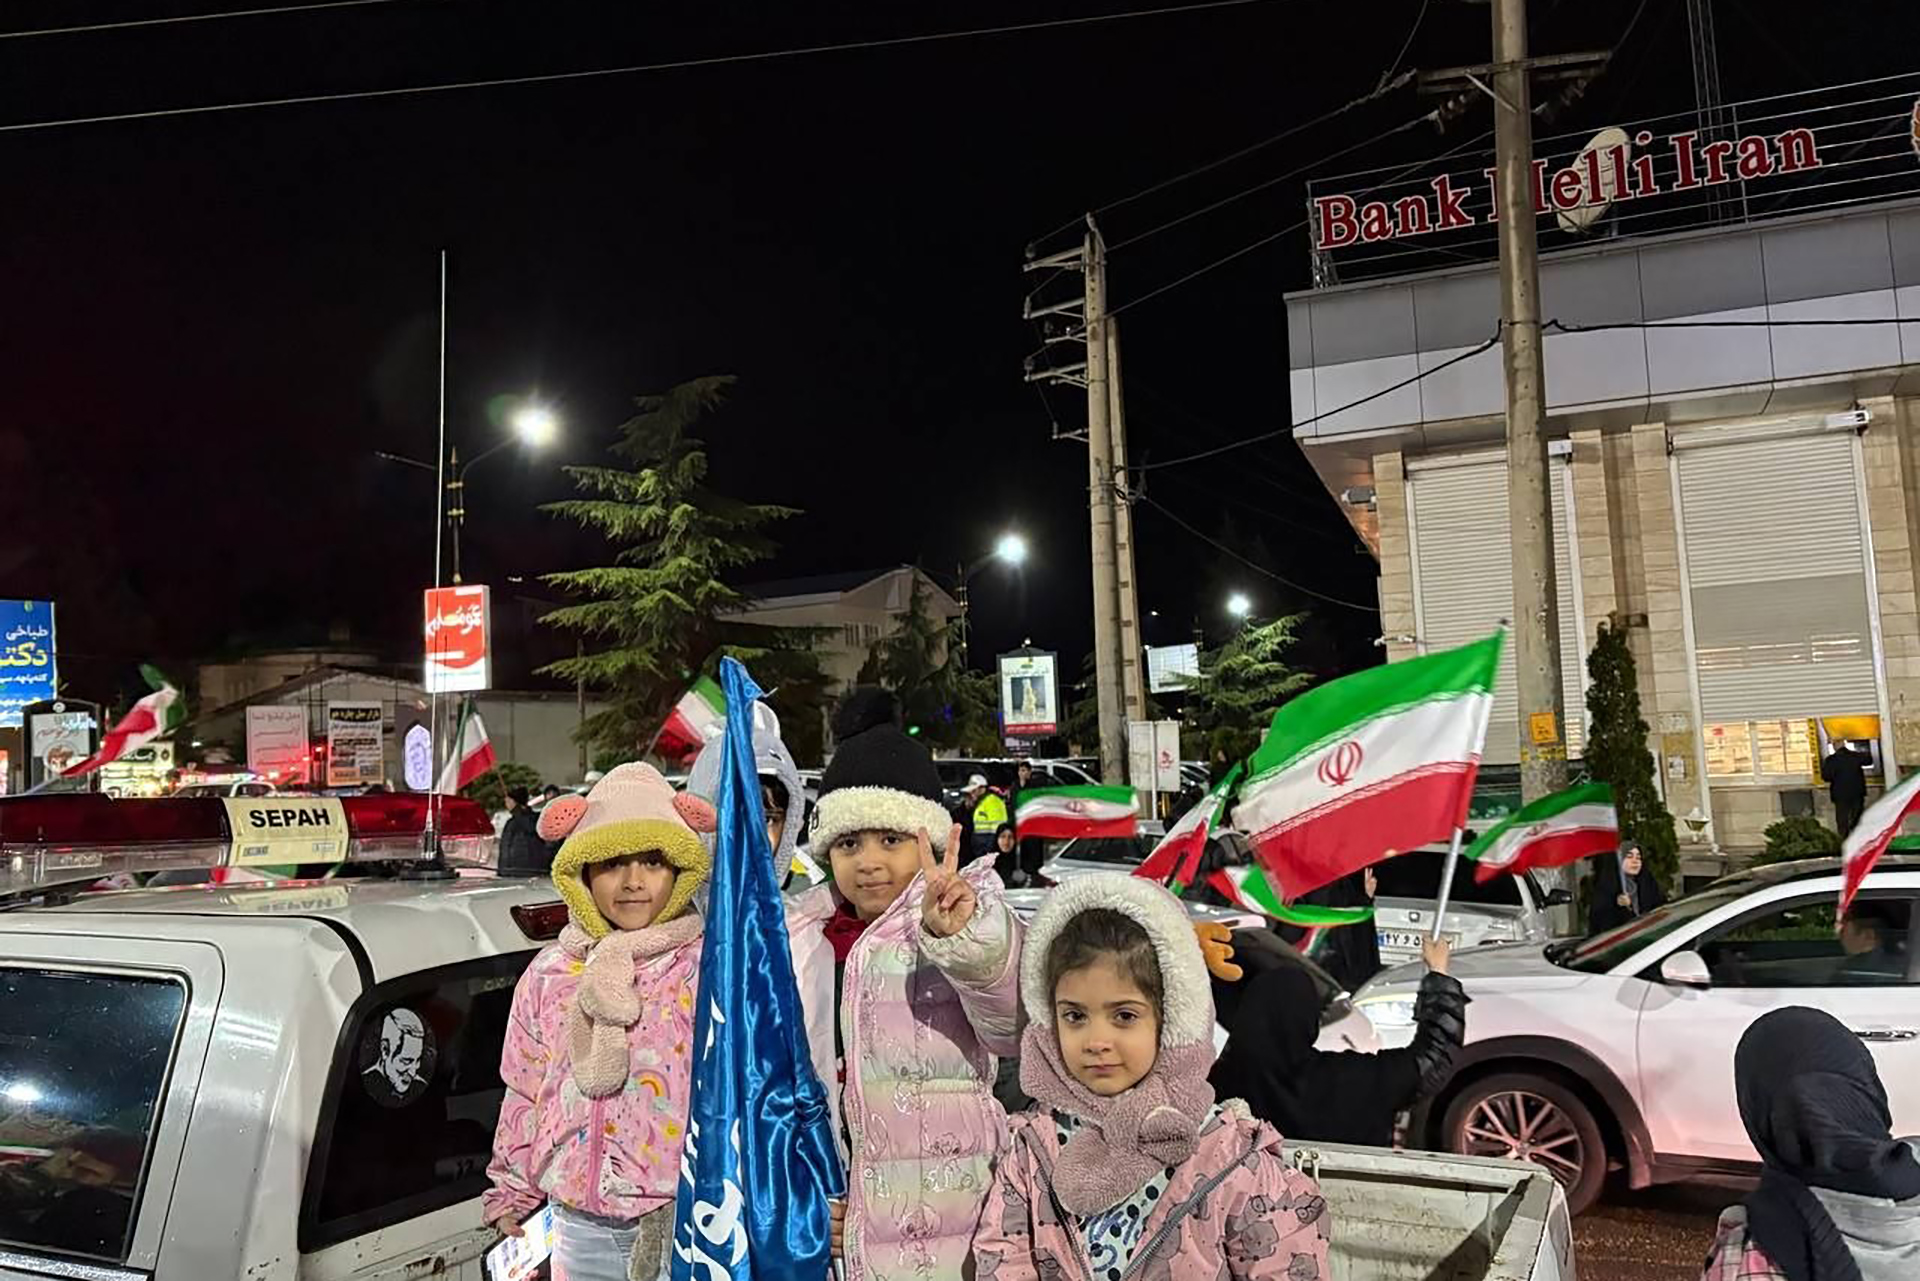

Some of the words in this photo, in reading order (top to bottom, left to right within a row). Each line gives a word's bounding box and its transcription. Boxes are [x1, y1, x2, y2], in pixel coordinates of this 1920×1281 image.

[1314, 173, 1475, 250] Bank
[1669, 128, 1824, 191] Iran
[6, 624, 49, 642] طباخی
[0, 641, 48, 667] دکت
[249, 808, 331, 829] SEPAH
